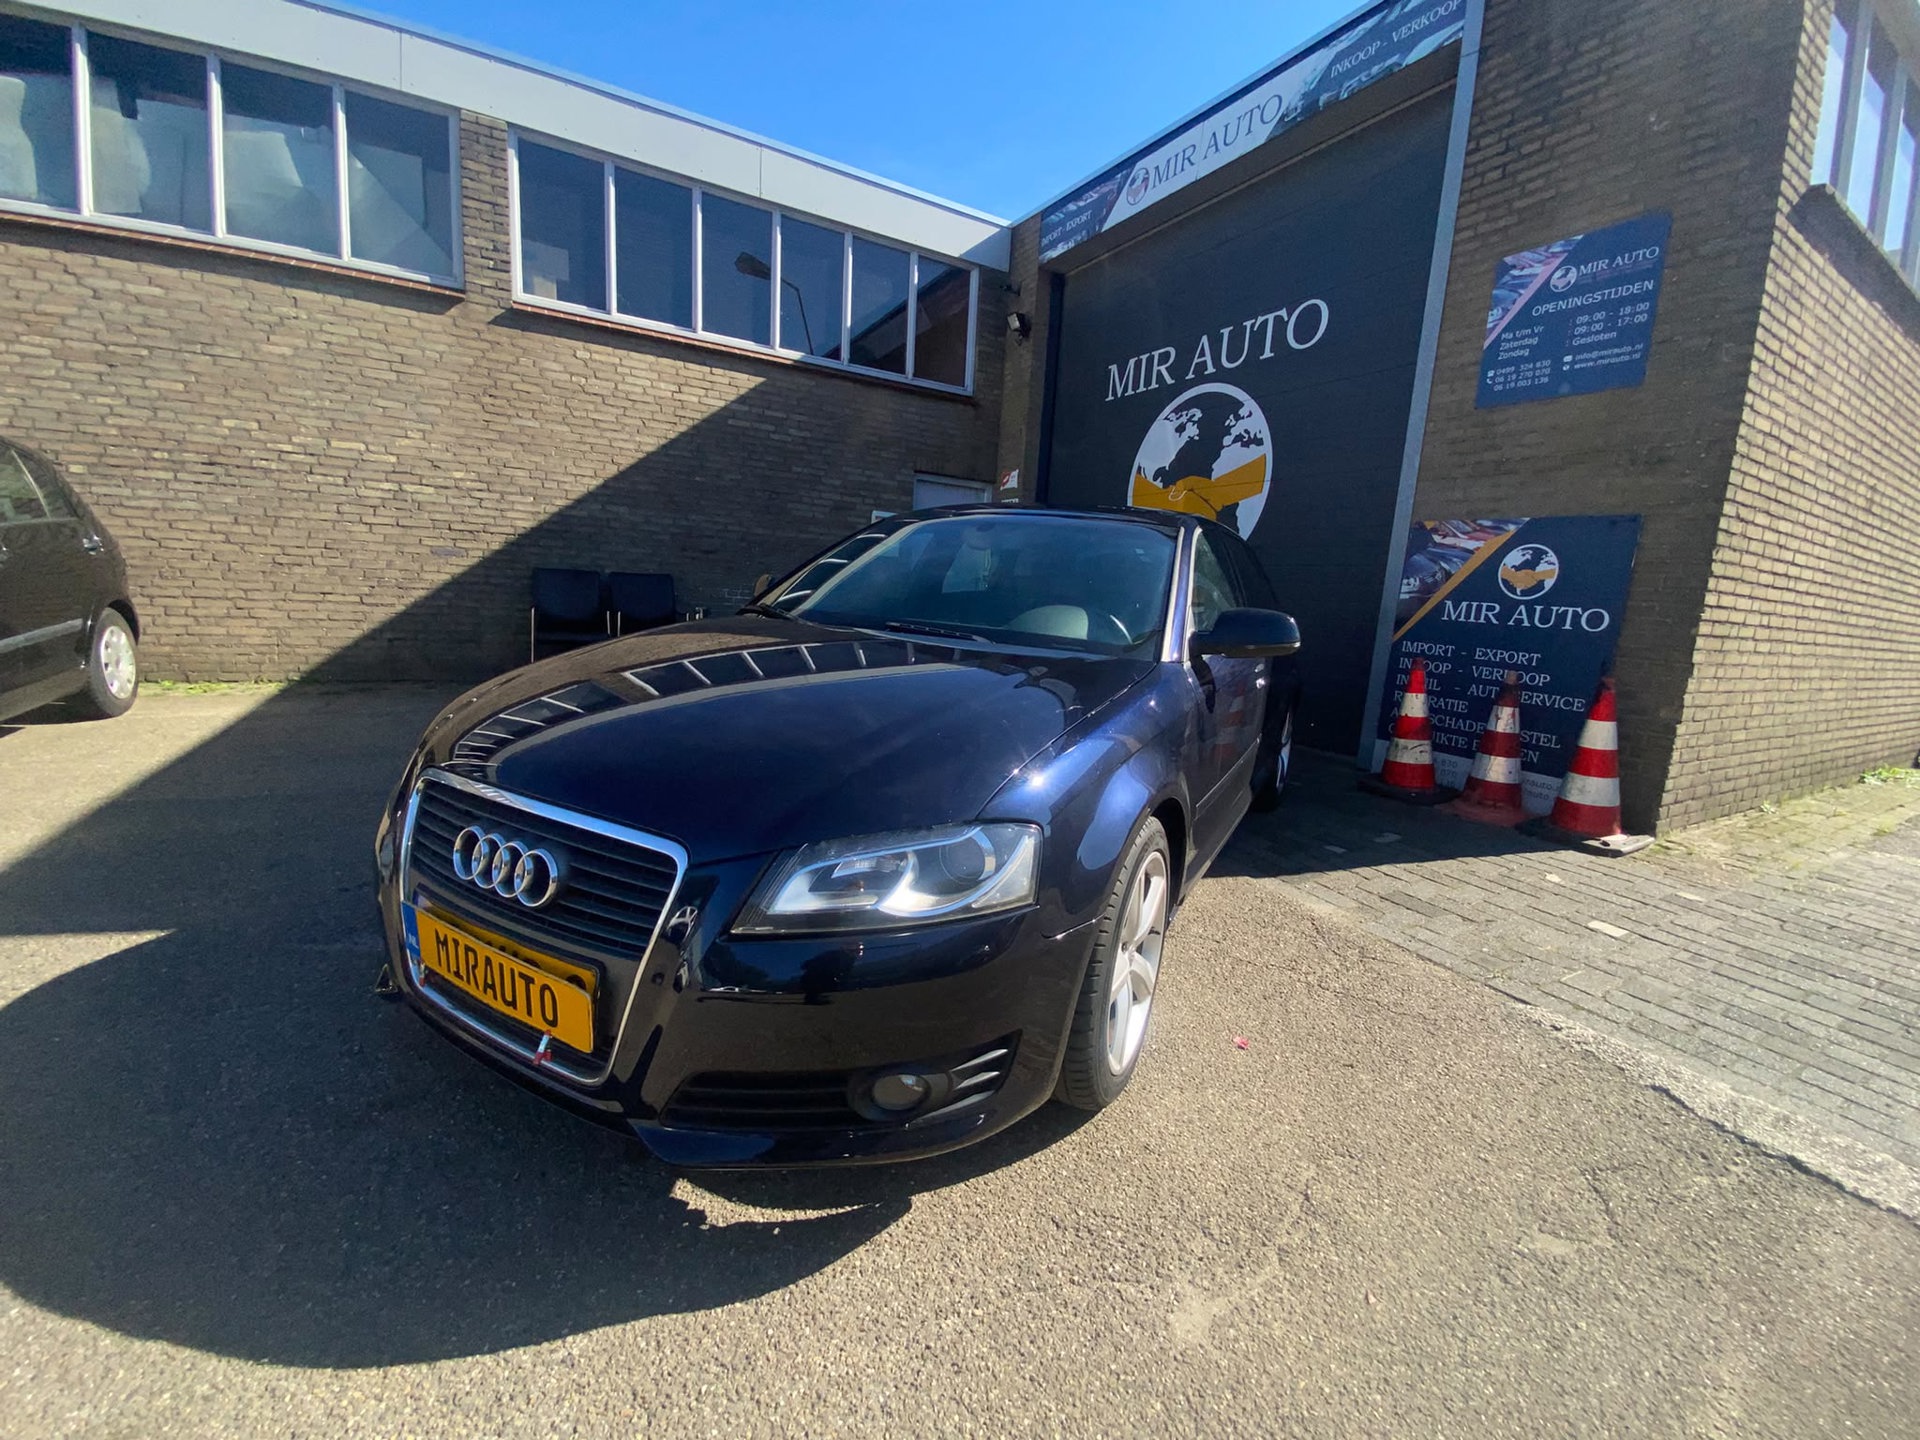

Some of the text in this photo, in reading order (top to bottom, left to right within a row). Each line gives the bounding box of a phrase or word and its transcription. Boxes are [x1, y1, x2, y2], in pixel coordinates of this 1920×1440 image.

[1330, 40, 1380, 78] INKOOP
[1392, 0, 1462, 43] VERKOOP
[1149, 93, 1283, 190] MIR AUTO
[1579, 259, 1609, 276] MIR
[1612, 246, 1660, 268] AUTO
[1532, 279, 1654, 317] OPENINGSTIJDEN
[1533, 325, 1545, 333] Vr
[1575, 311, 1606, 324] 09:00
[1104, 298, 1330, 402] MIR AUTO
[1497, 348, 1530, 360] Zondag
[1572, 331, 1617, 346] Gesloten
[1499, 336, 1539, 350] Zaterdag
[1441, 600, 1610, 632] MIR AUTO
[1399, 657, 1452, 674] INOOP
[1401, 640, 1456, 657] IMPORT
[1474, 647, 1542, 666] EXPORT
[434, 928, 559, 1028] MIRAUTO
